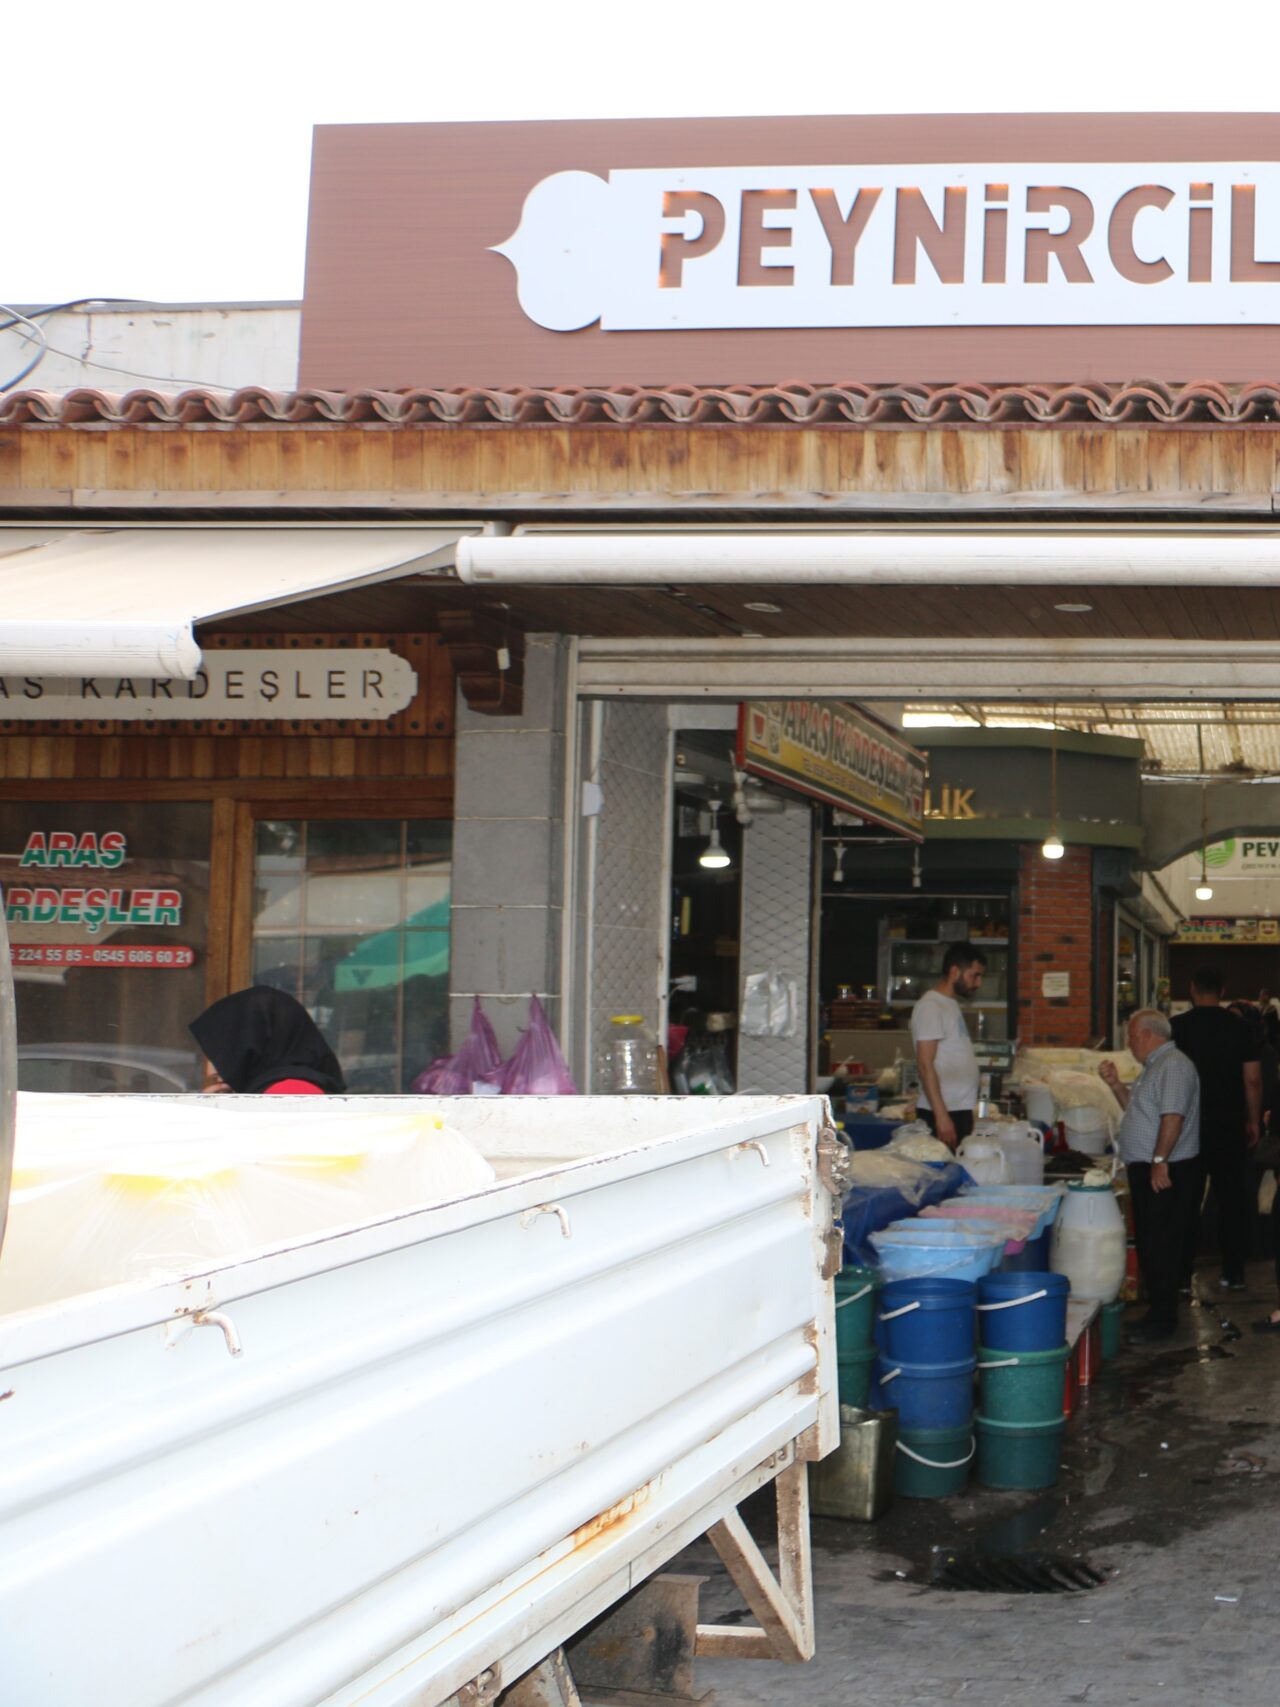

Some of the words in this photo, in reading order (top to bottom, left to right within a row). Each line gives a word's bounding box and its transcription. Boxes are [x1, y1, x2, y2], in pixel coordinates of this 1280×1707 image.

[82, 670, 384, 701] KARDEŞLER
[785, 699, 831, 761] ARAS
[19, 832, 127, 869] ARAS
[156, 950, 172, 962] 60
[176, 950, 192, 963] 21
